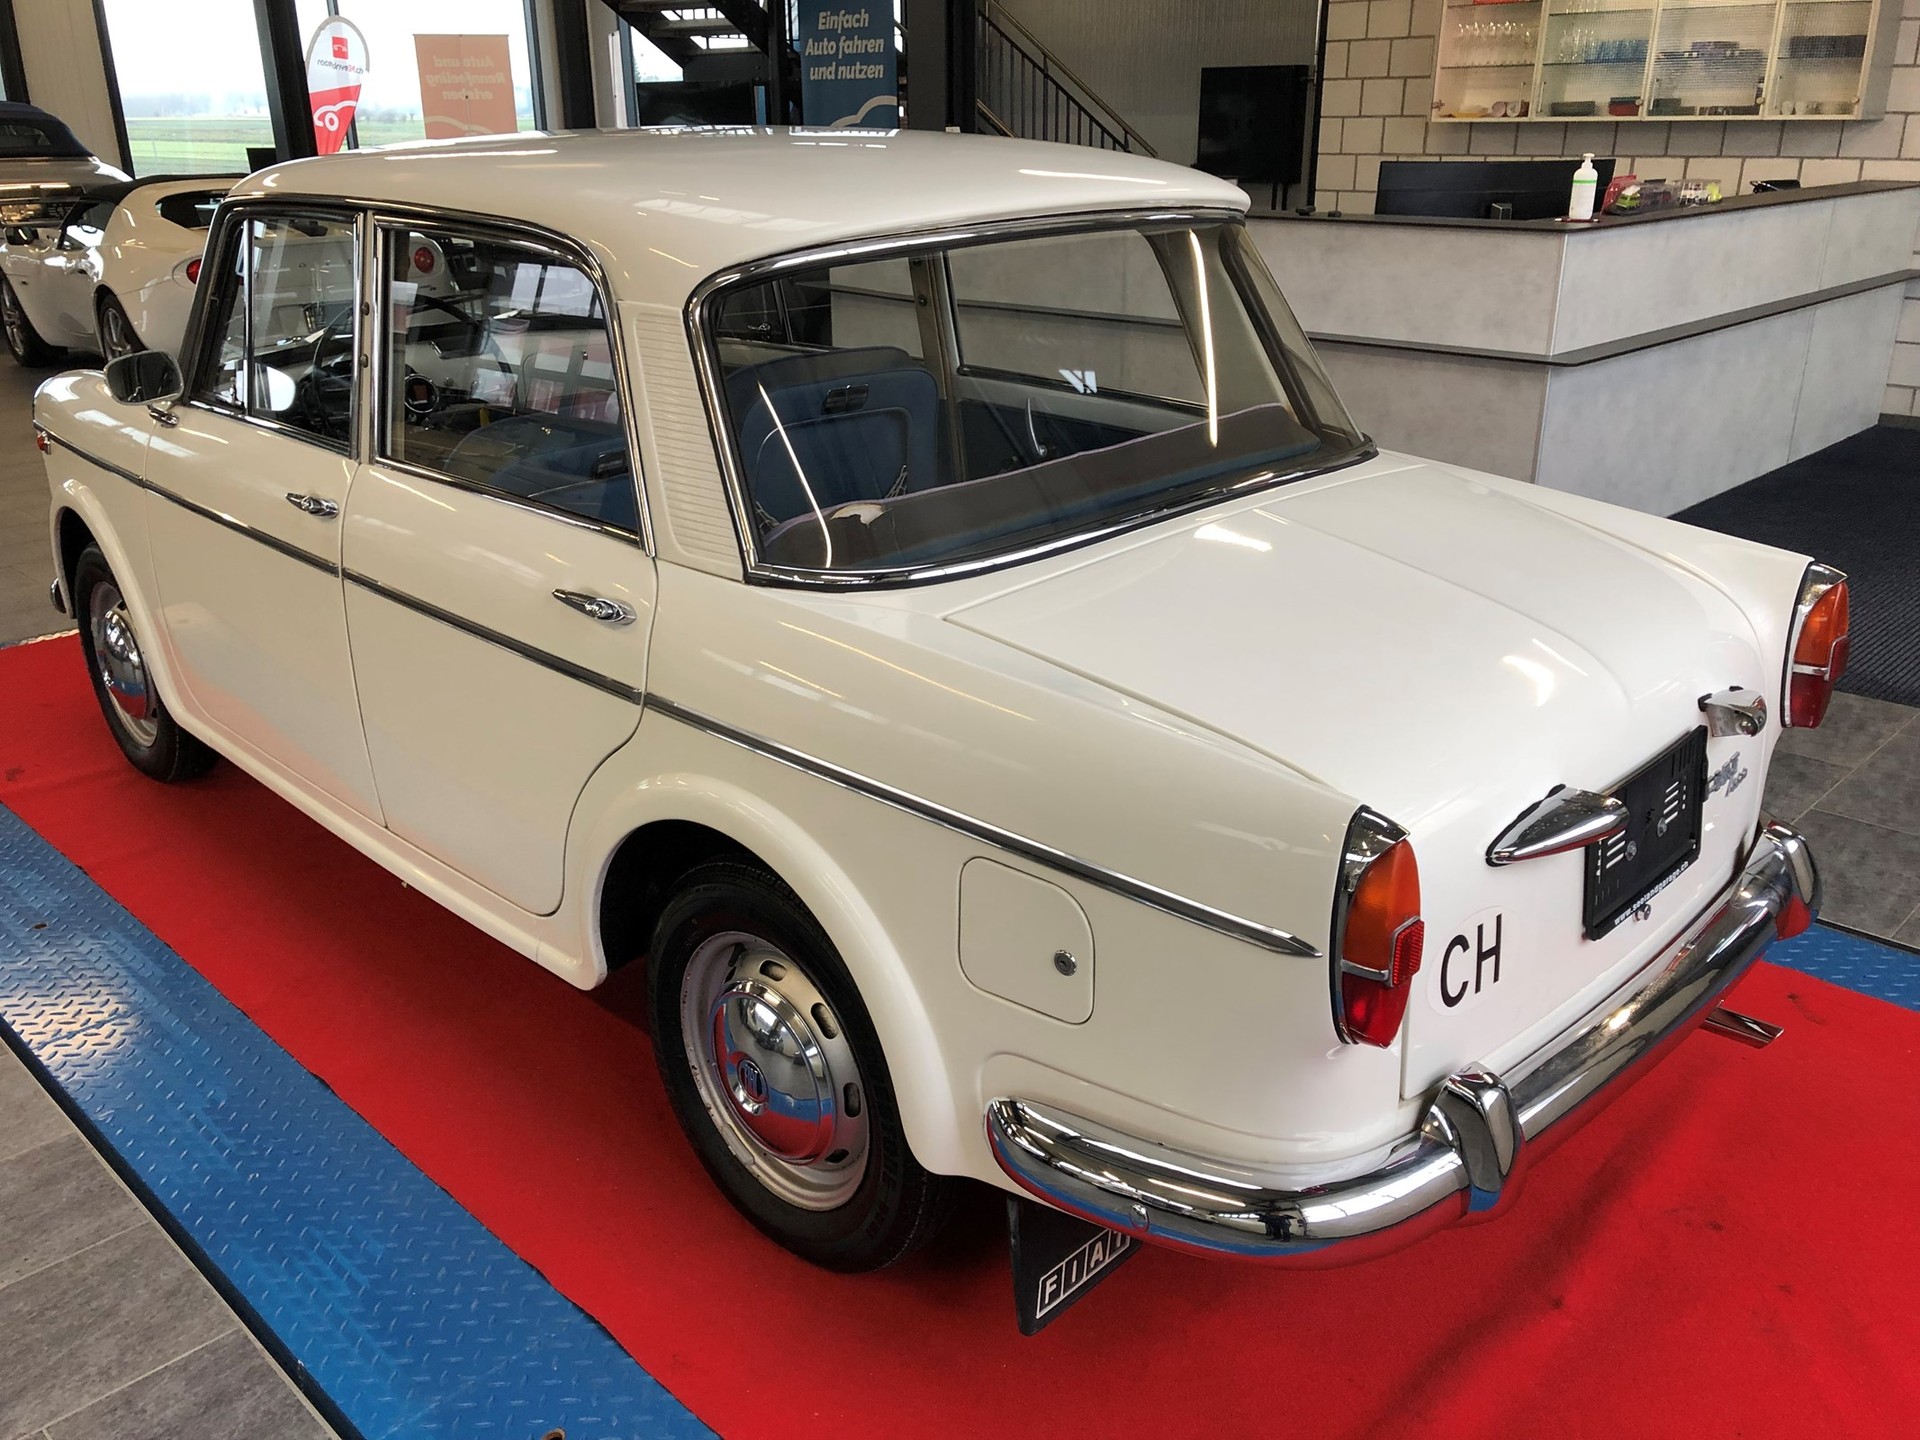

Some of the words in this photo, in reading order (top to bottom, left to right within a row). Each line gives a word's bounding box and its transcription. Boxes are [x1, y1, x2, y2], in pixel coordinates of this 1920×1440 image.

[818, 9, 869, 33] Einfach
[805, 38, 836, 56] Auto
[838, 35, 885, 59] fahren
[810, 62, 836, 80] und
[837, 62, 884, 79] nutzen
[1440, 913, 1502, 1008] CH
[1045, 1230, 1122, 1304] FIAT
